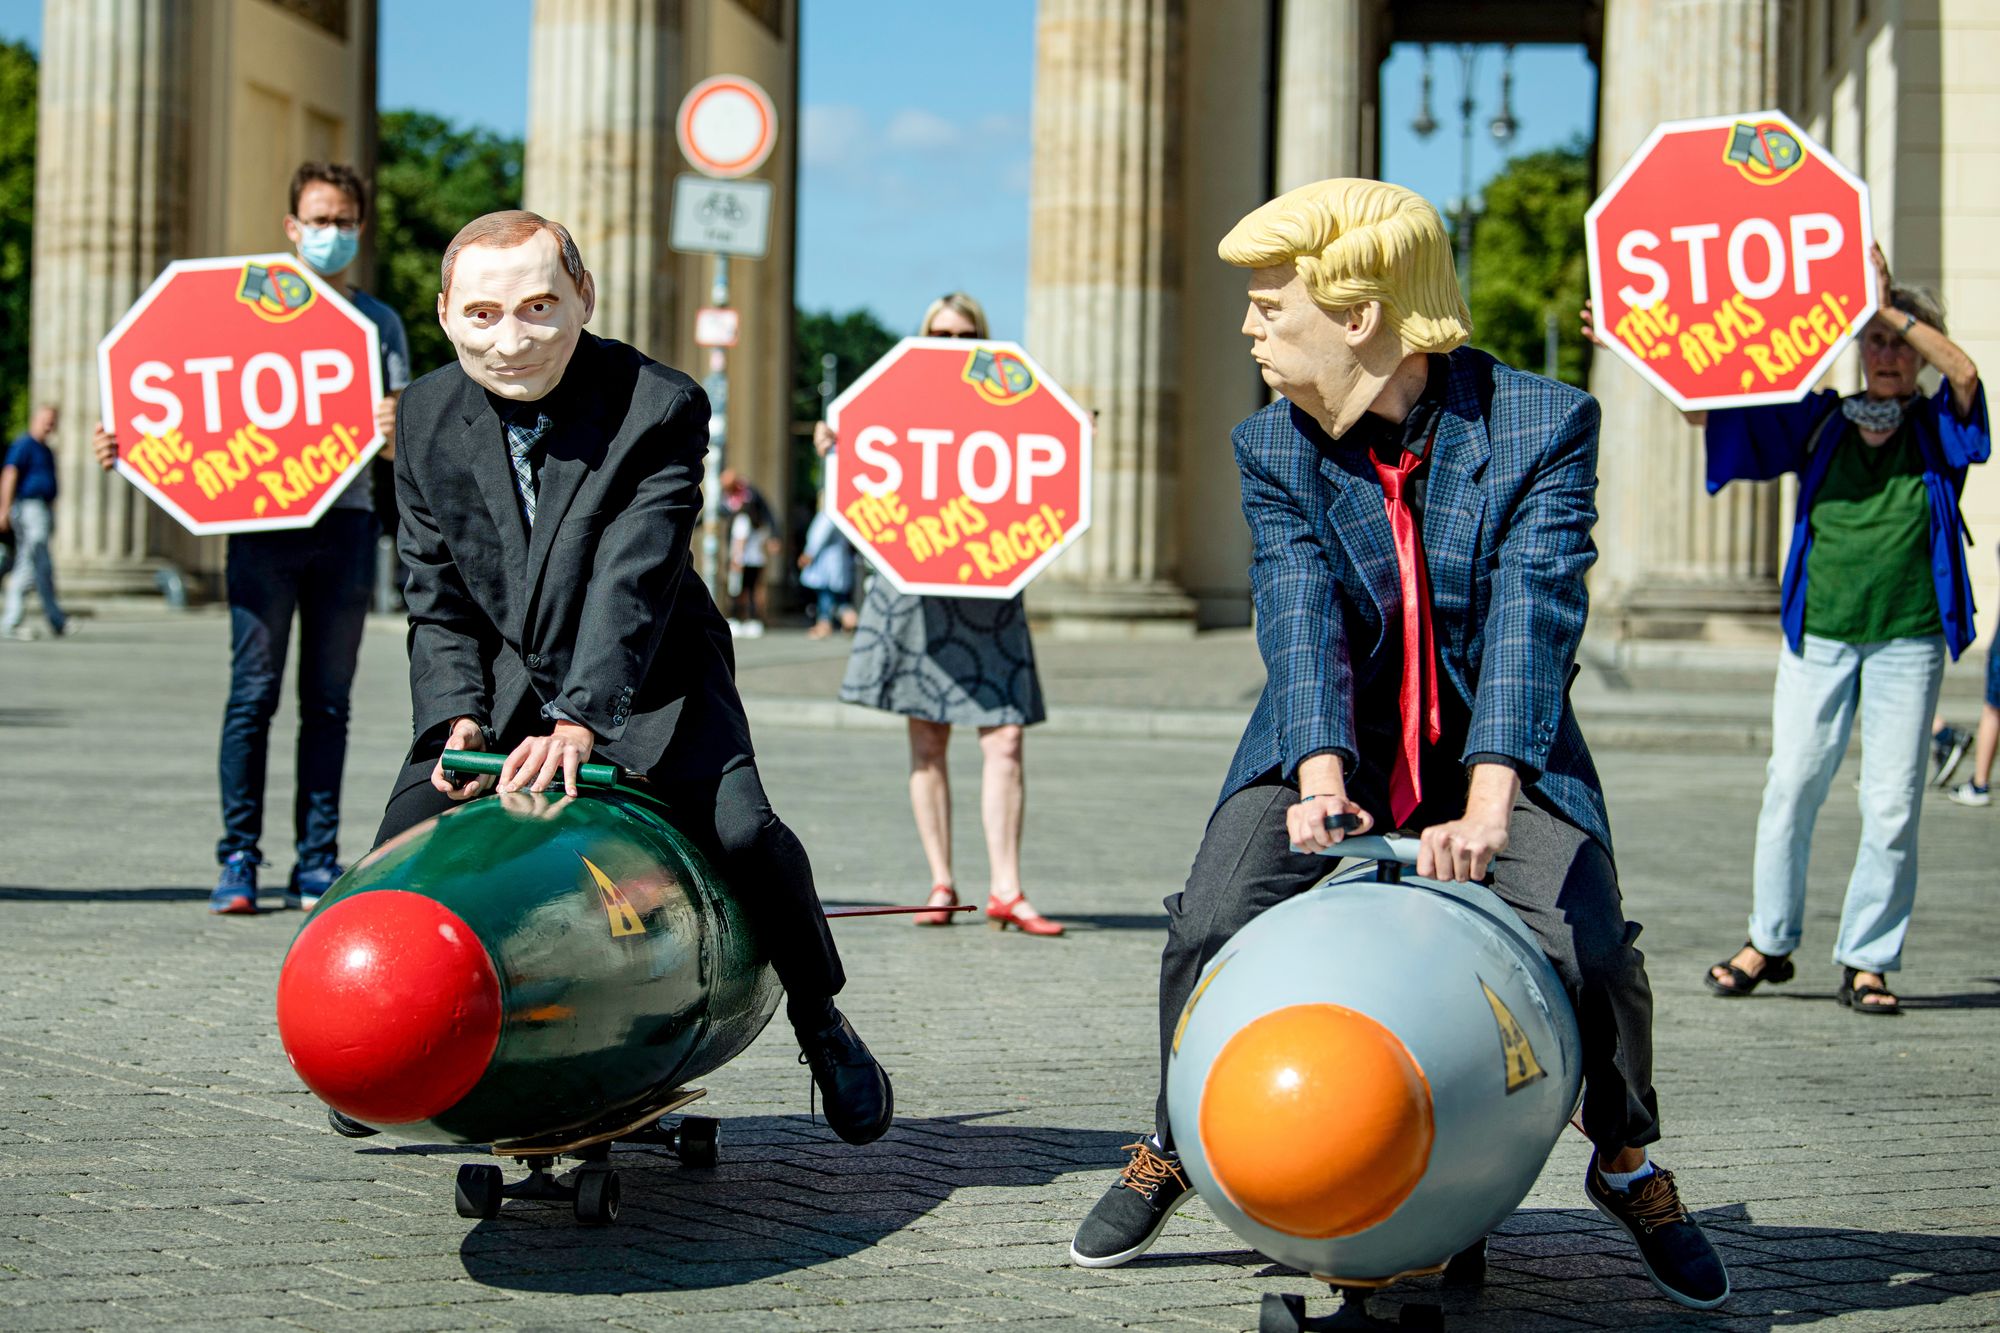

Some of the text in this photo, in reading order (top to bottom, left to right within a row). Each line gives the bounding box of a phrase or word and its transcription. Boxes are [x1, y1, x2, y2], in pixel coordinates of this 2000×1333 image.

[1616, 212, 1844, 309] STOP
[1615, 300, 1680, 358] THE
[1678, 293, 1766, 375] ARMS
[129, 348, 355, 438] STOP
[126, 427, 194, 485] THE
[191, 423, 279, 500] ARMS
[851, 425, 1067, 504] STOP
[845, 491, 909, 543] THE
[904, 495, 989, 563] ARMS
